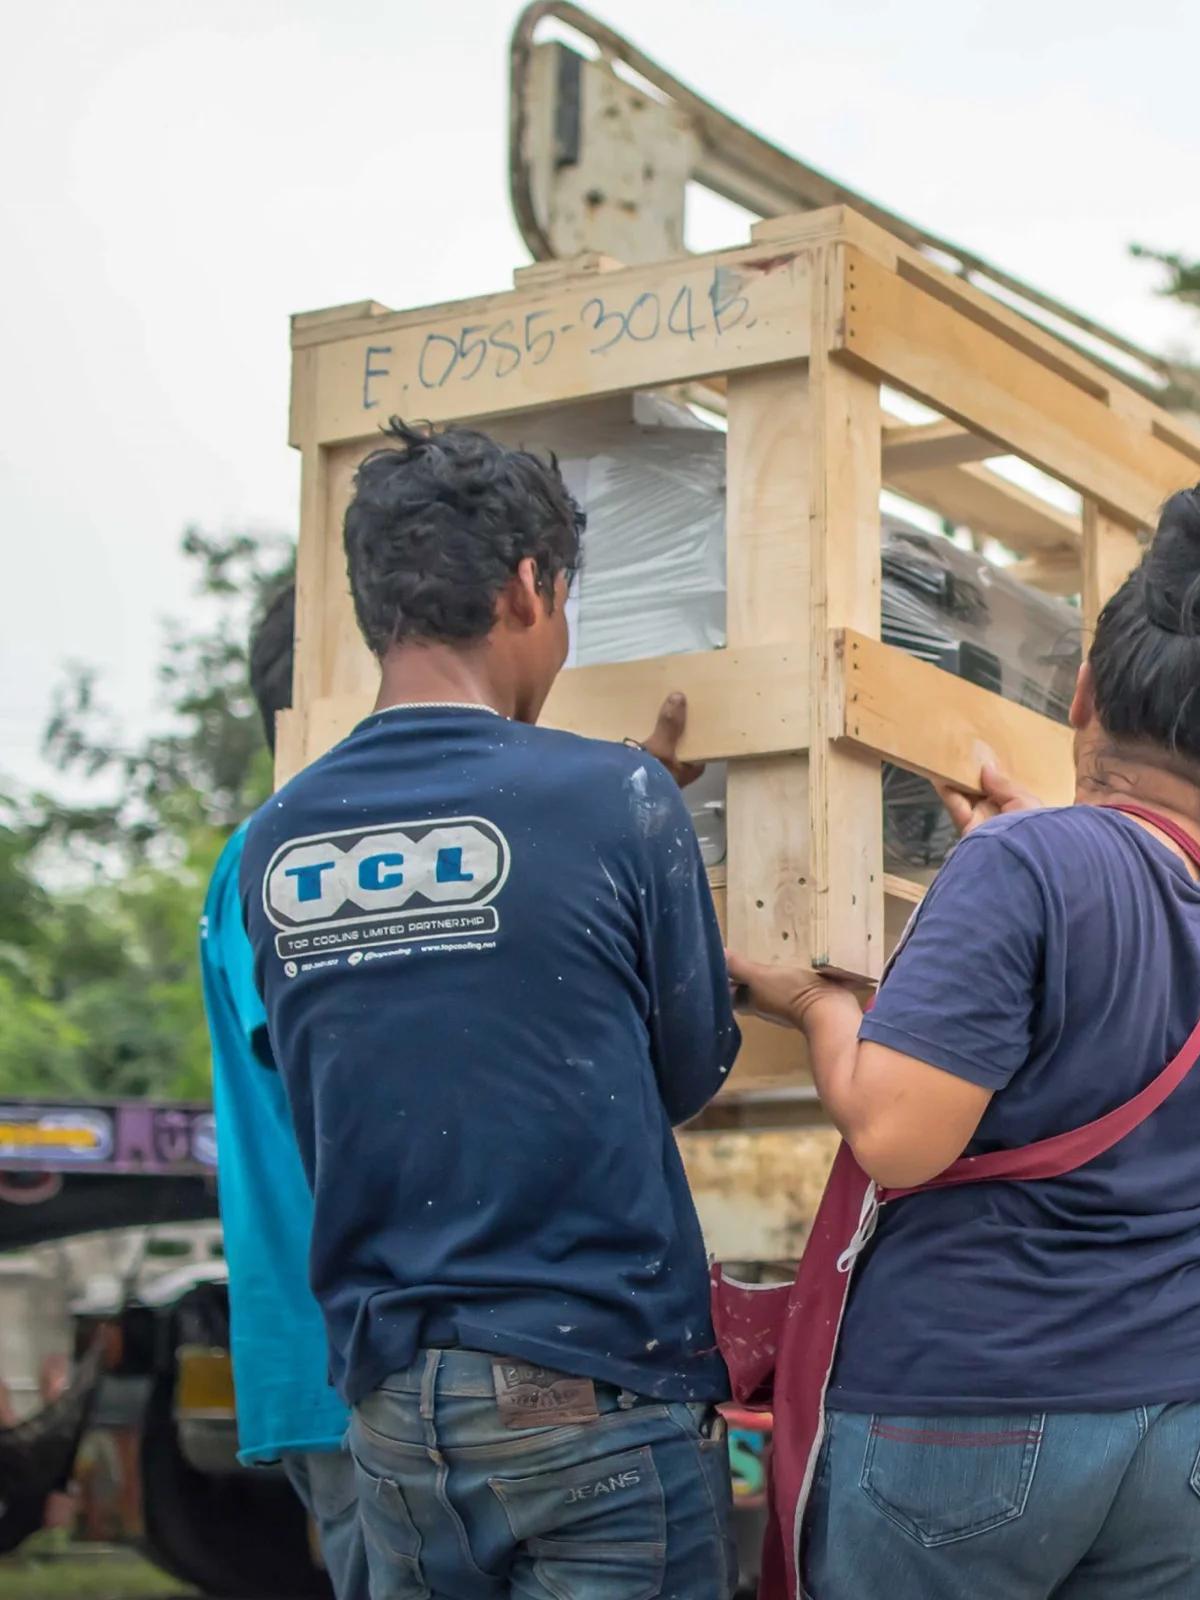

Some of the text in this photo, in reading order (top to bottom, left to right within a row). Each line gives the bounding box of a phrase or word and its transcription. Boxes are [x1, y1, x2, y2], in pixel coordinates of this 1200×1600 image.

[285, 846, 474, 903] TCL
[287, 916, 486, 950] TOP COOLING LIMITED PARTNERSHIP
[564, 1470, 641, 1504] JEANS
